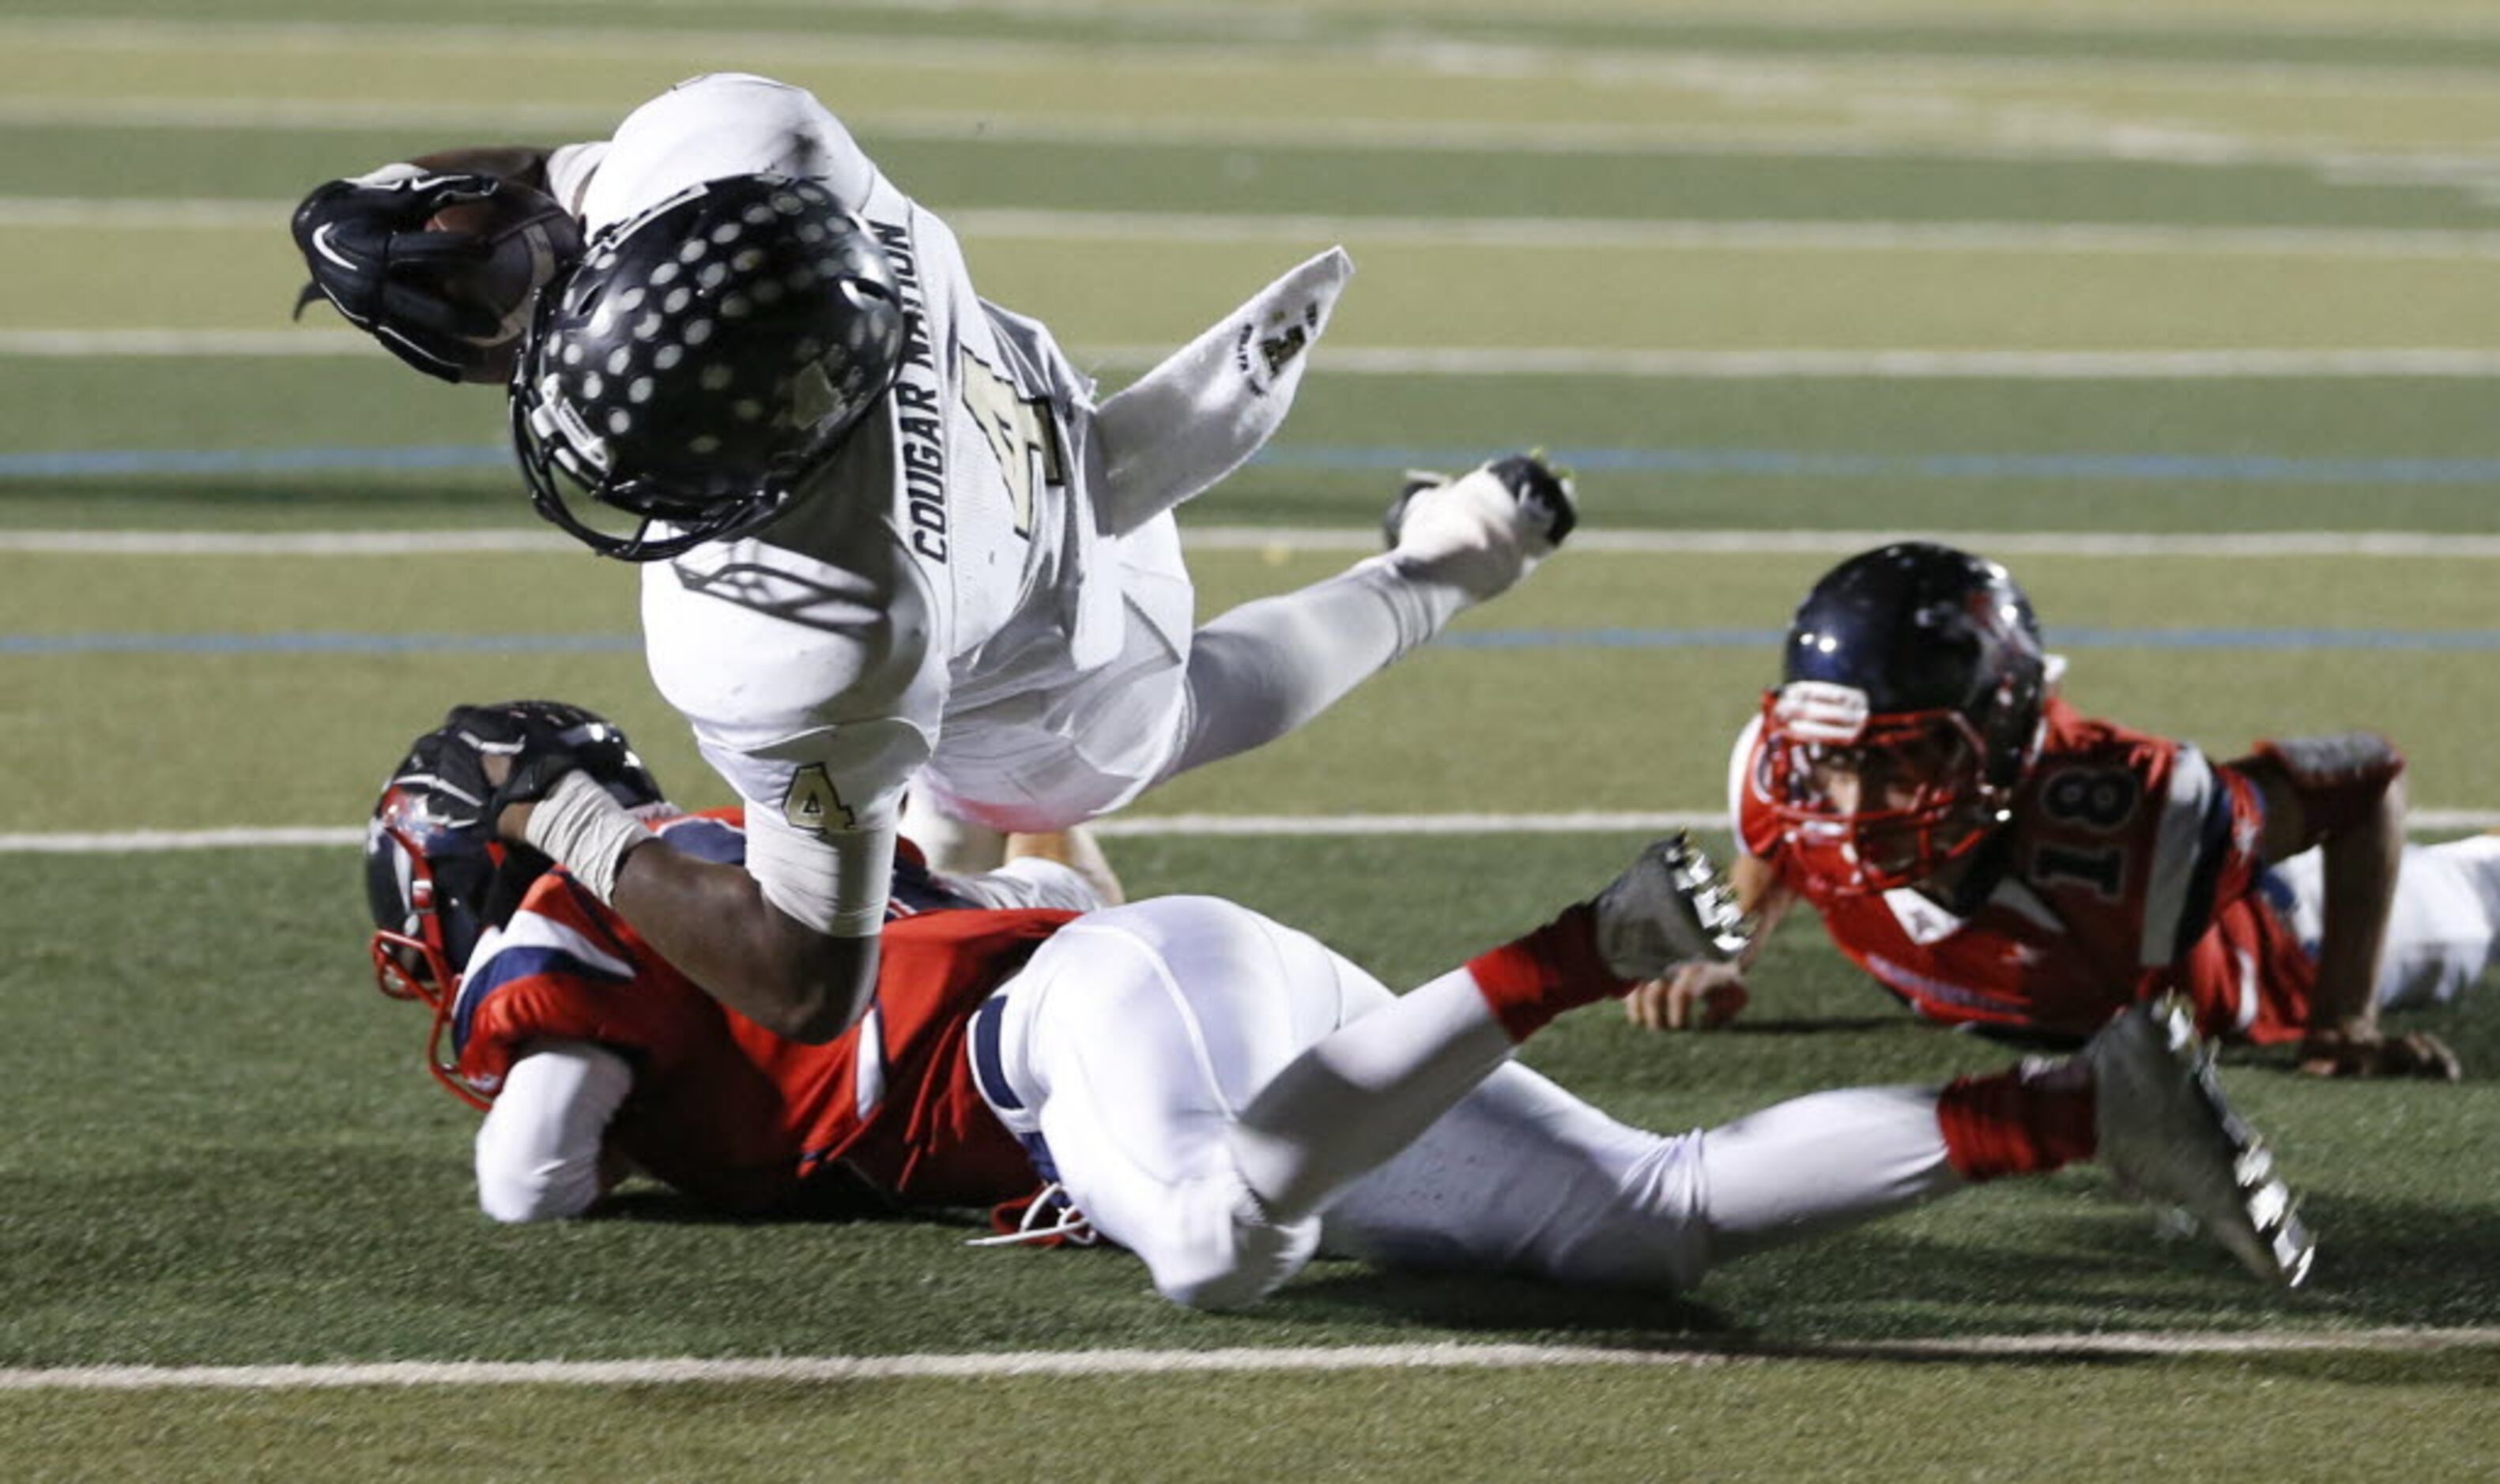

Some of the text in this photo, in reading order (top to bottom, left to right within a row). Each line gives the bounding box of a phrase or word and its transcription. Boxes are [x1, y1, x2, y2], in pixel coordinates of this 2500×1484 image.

[896, 382, 947, 564] COUGAR
[960, 341, 1065, 541] 4
[781, 762, 855, 834] 4
[2031, 768, 2138, 902] 18
